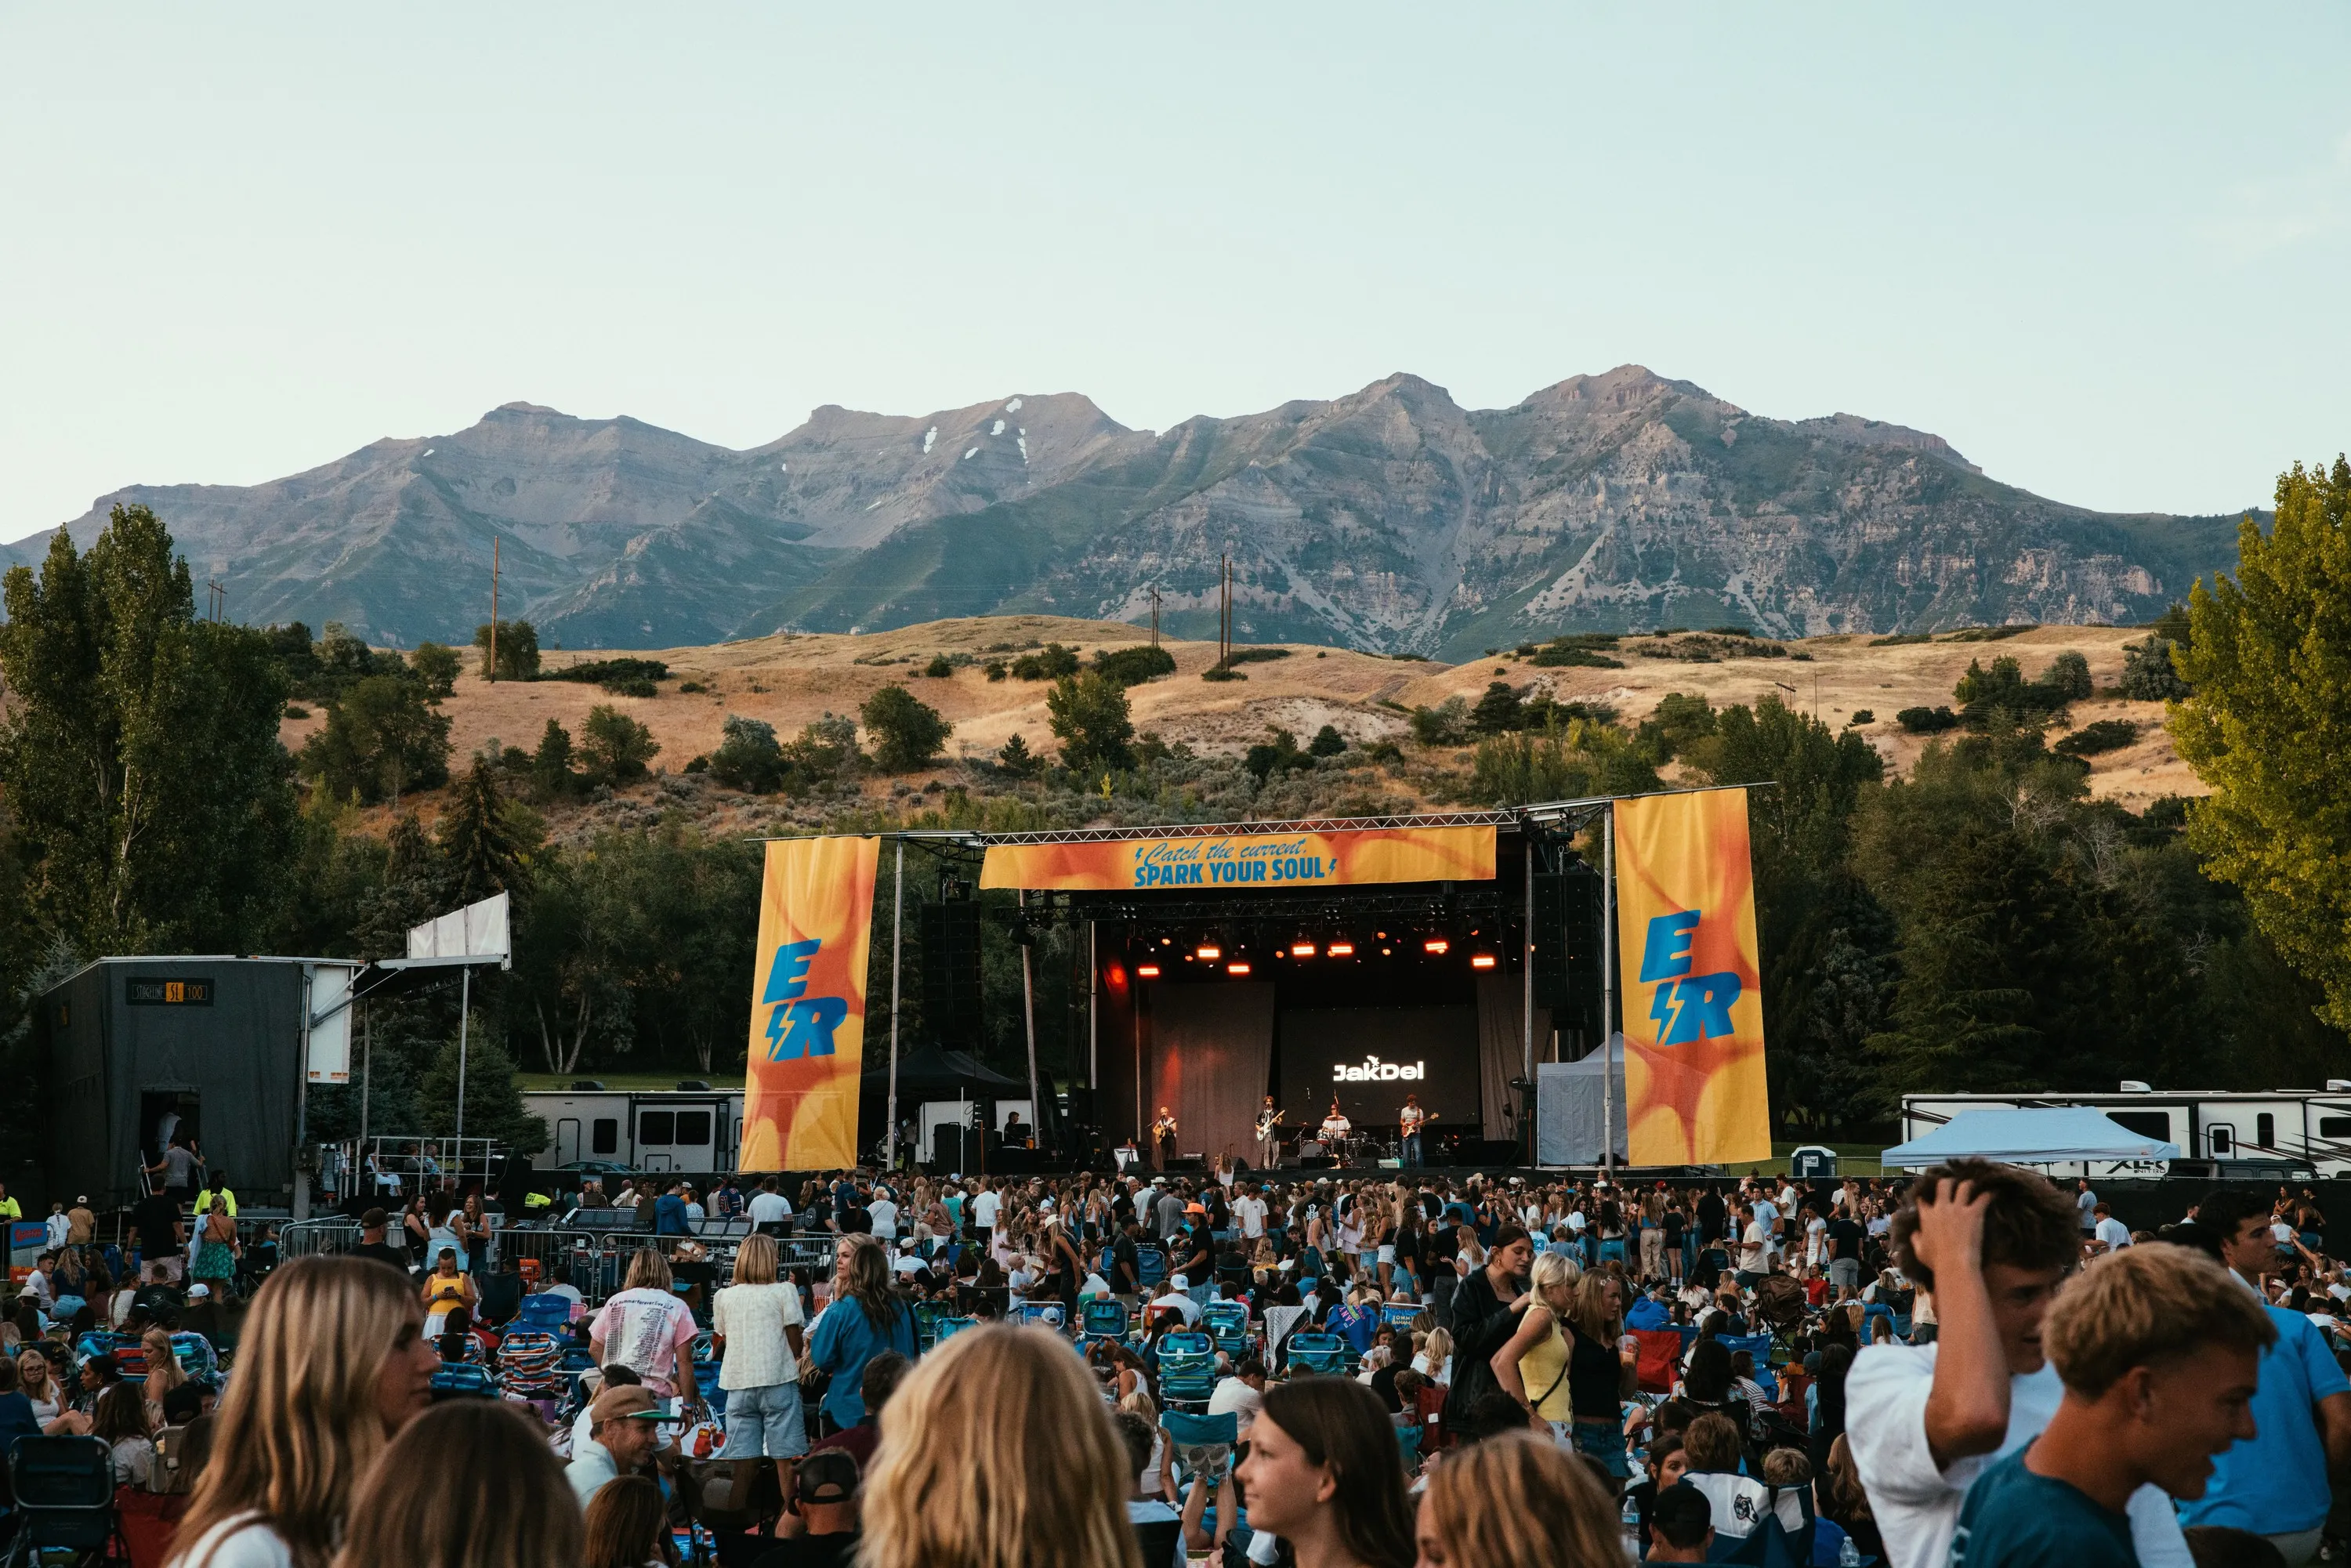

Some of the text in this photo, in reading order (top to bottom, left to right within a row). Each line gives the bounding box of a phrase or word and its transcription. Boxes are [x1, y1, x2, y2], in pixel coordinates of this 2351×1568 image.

[1144, 840, 1204, 866] Catch
[1206, 838, 1234, 860] the
[1135, 856, 1324, 887] SPARK YOUR SOUL
[136, 983, 203, 1001] STAGELINE SL 100
[1333, 1060, 1424, 1081] JakDel
[1533, 1239, 1545, 1251] 23
[1339, 1306, 1355, 1326] LANY
